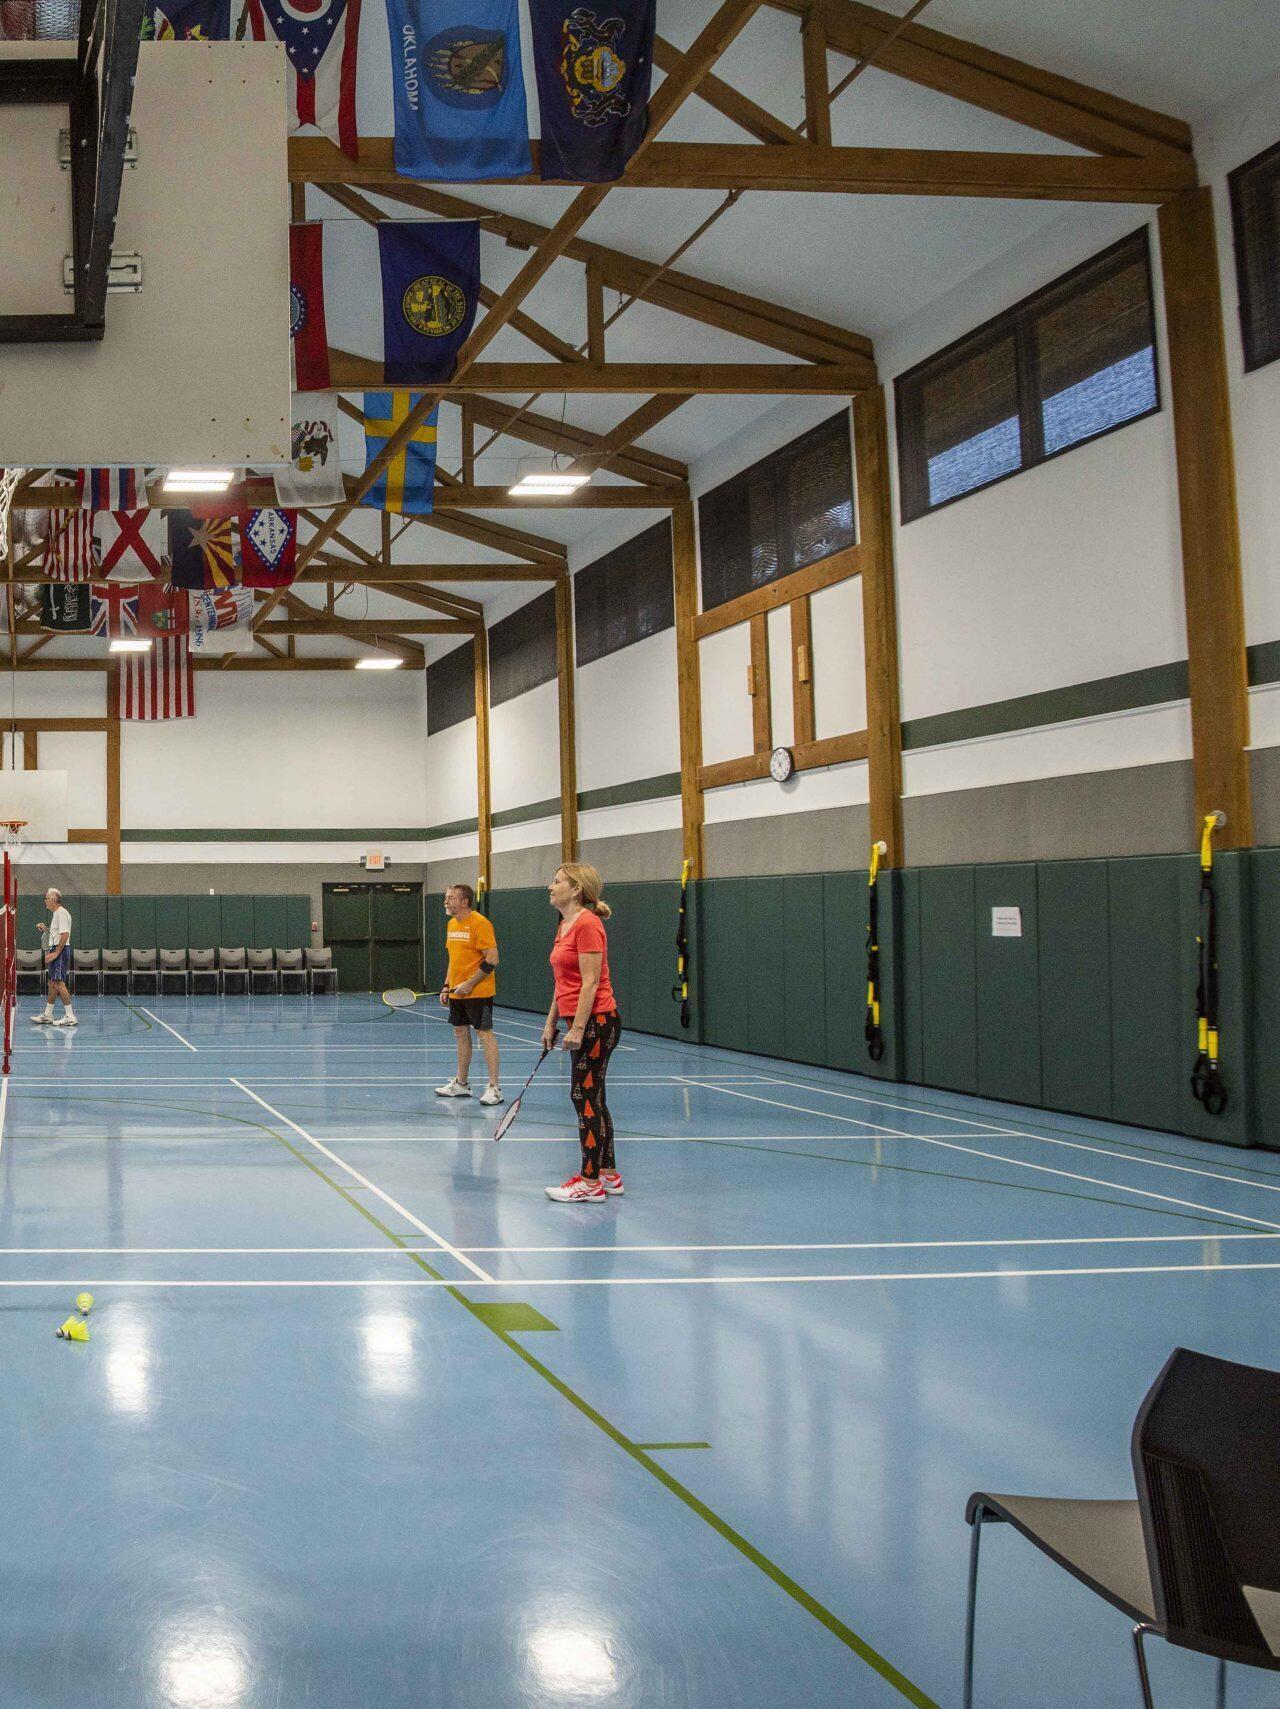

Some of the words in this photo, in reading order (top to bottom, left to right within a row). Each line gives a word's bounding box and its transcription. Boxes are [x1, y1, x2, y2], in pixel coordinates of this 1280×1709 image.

[403, 25, 419, 110] OKLAHOMA
[268, 511, 276, 555] ARKANSAS
[369, 855, 381, 865] EXIT
